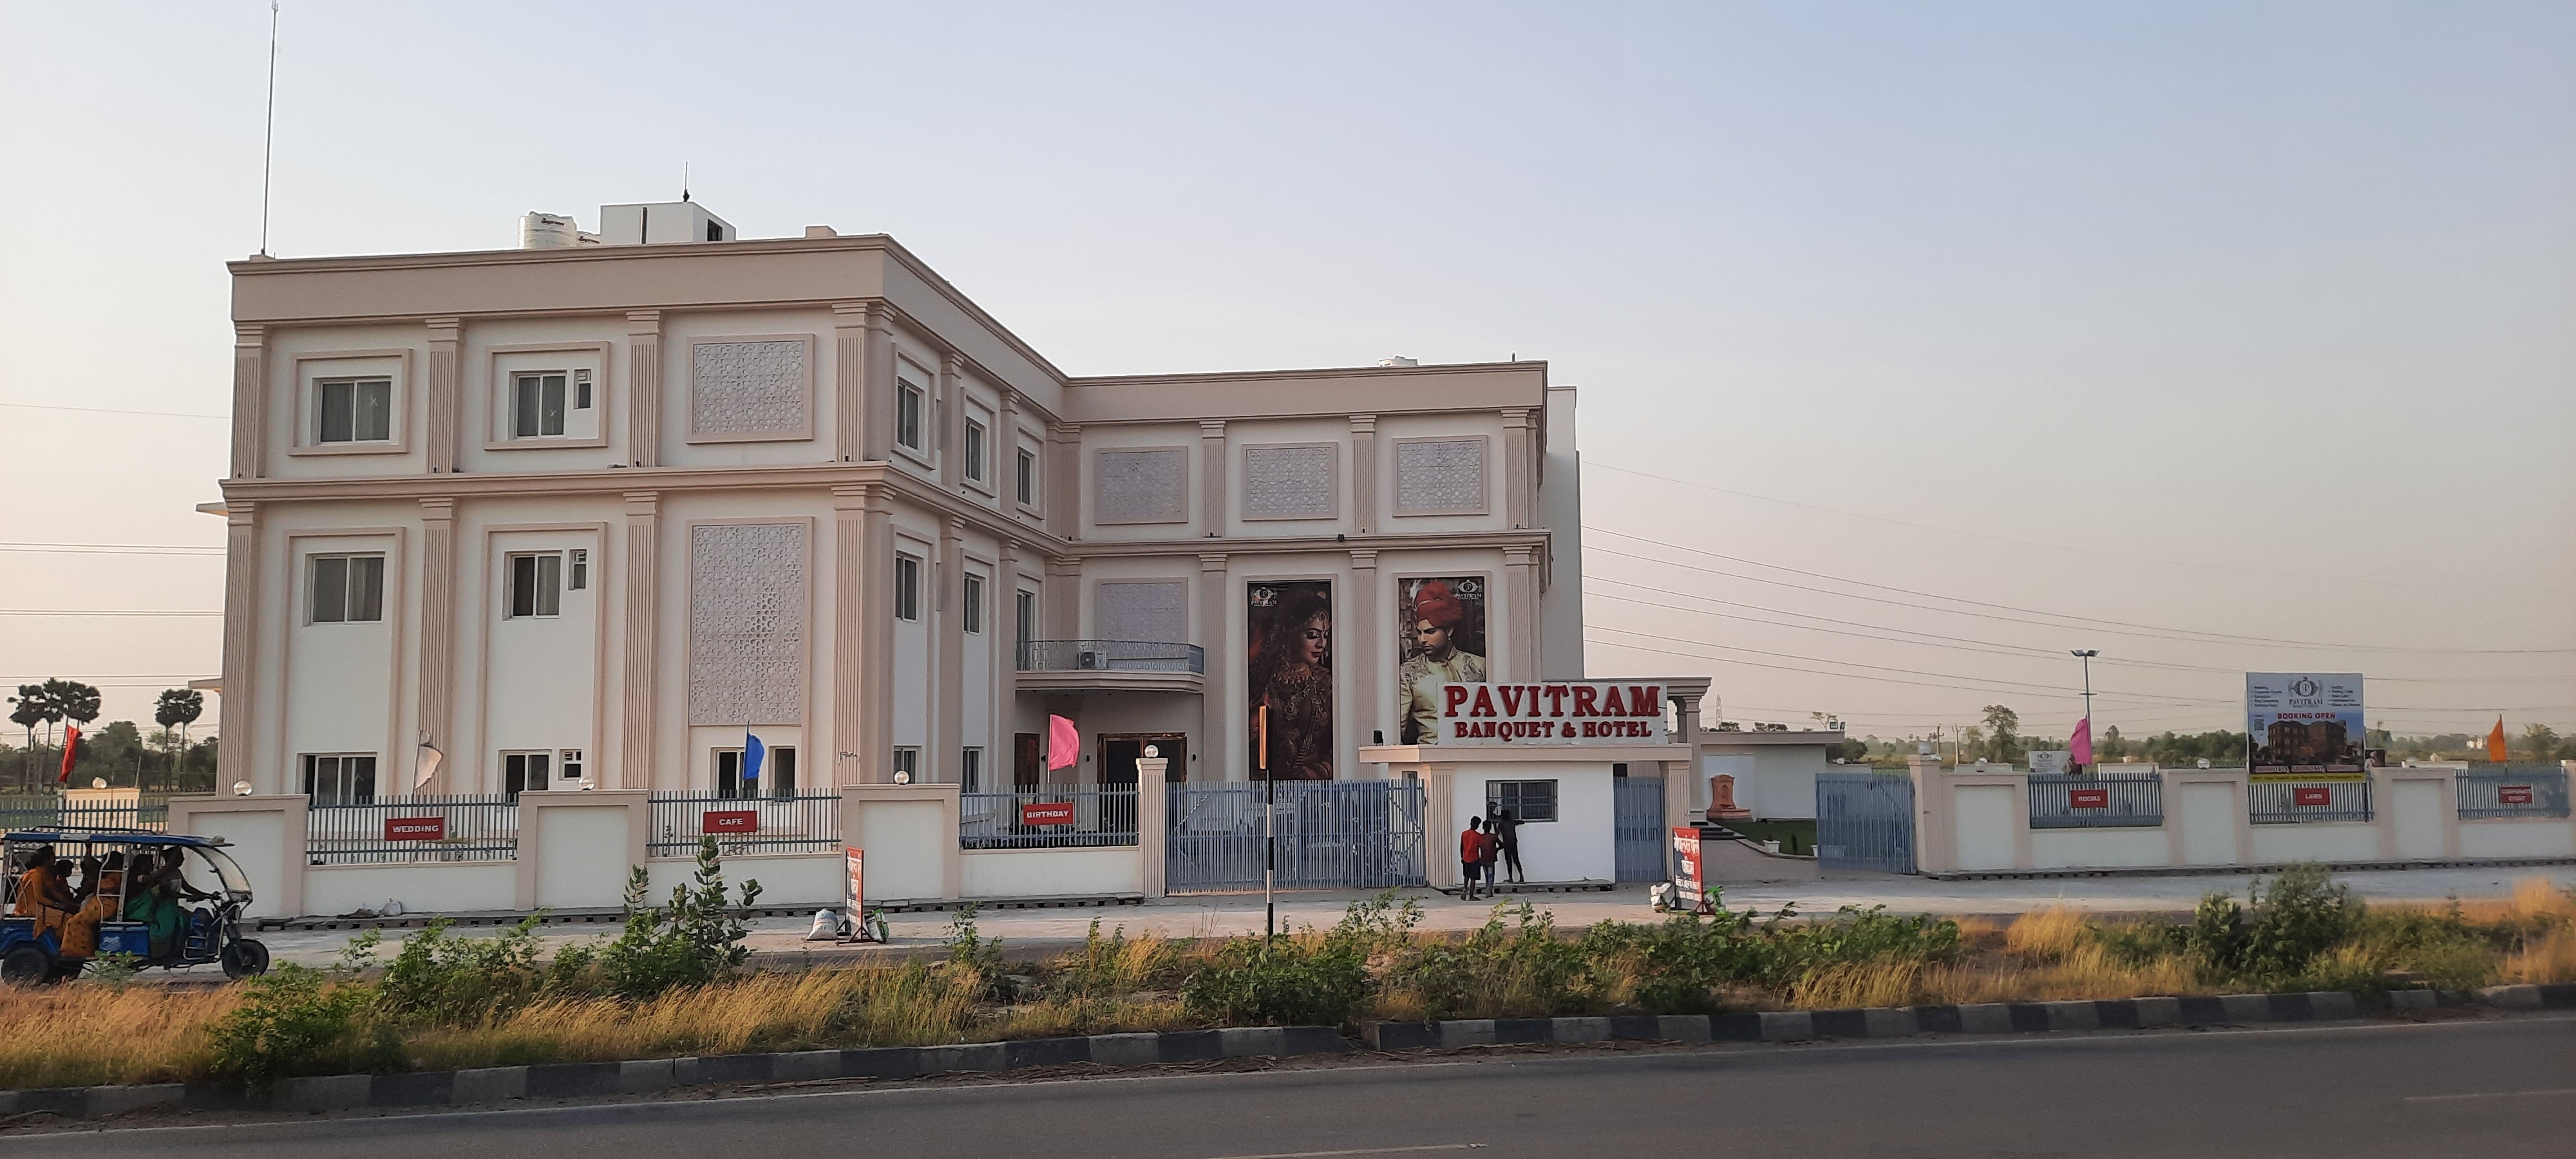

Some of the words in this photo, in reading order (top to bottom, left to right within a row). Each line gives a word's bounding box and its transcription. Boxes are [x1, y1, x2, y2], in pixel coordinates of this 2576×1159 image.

[1444, 685, 1661, 717] PAVITRAM
[1454, 721, 1555, 741] BANQUET
[1561, 722, 1577, 737] &
[1582, 721, 1652, 737] HOTEL
[1027, 810, 1069, 818] BIRTHDAY
